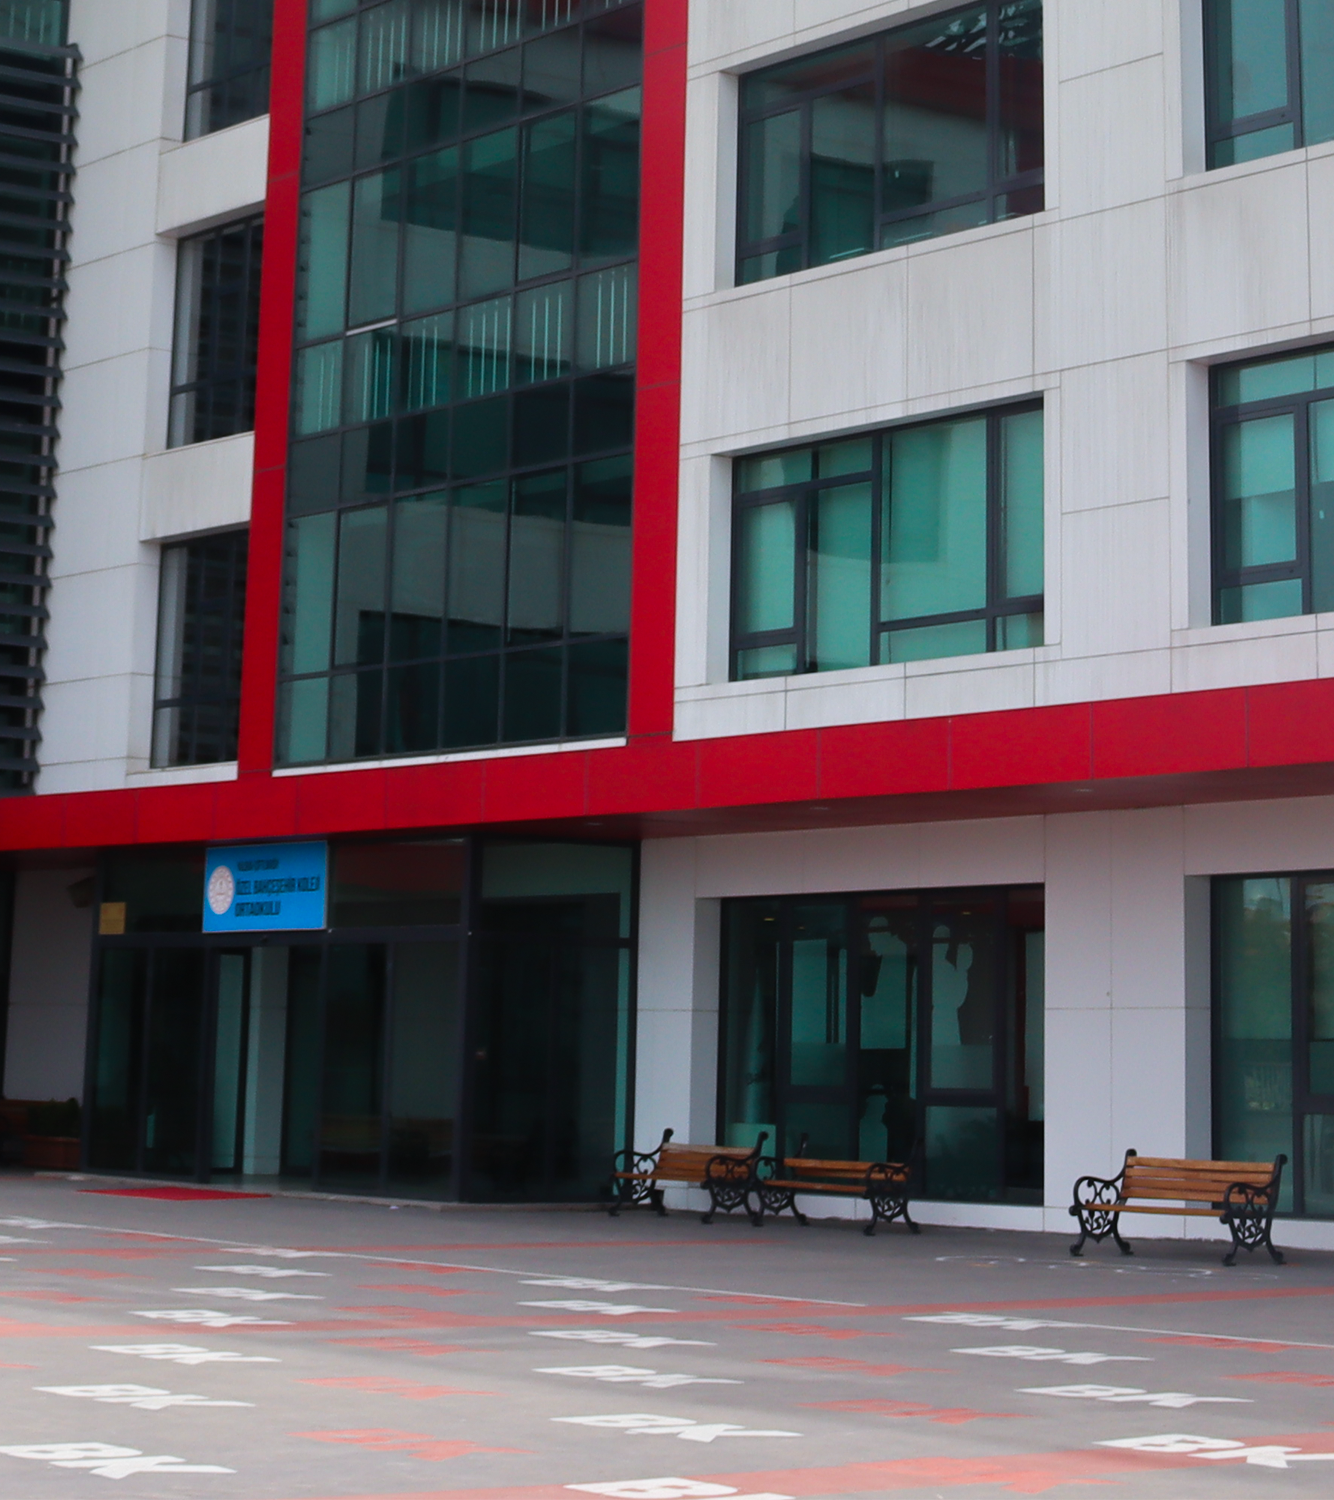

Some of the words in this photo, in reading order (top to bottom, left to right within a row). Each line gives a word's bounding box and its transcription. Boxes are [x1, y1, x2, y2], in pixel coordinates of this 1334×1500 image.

[527, 1330, 717, 1349] BK
[87, 1343, 281, 1365] BK
[948, 1345, 1155, 1365] BK
[531, 1365, 744, 1388] BK
[30, 1384, 256, 1410] BK
[1013, 1384, 1254, 1409] BK
[549, 1413, 804, 1443] BK
[285, 1427, 537, 1462] BK
